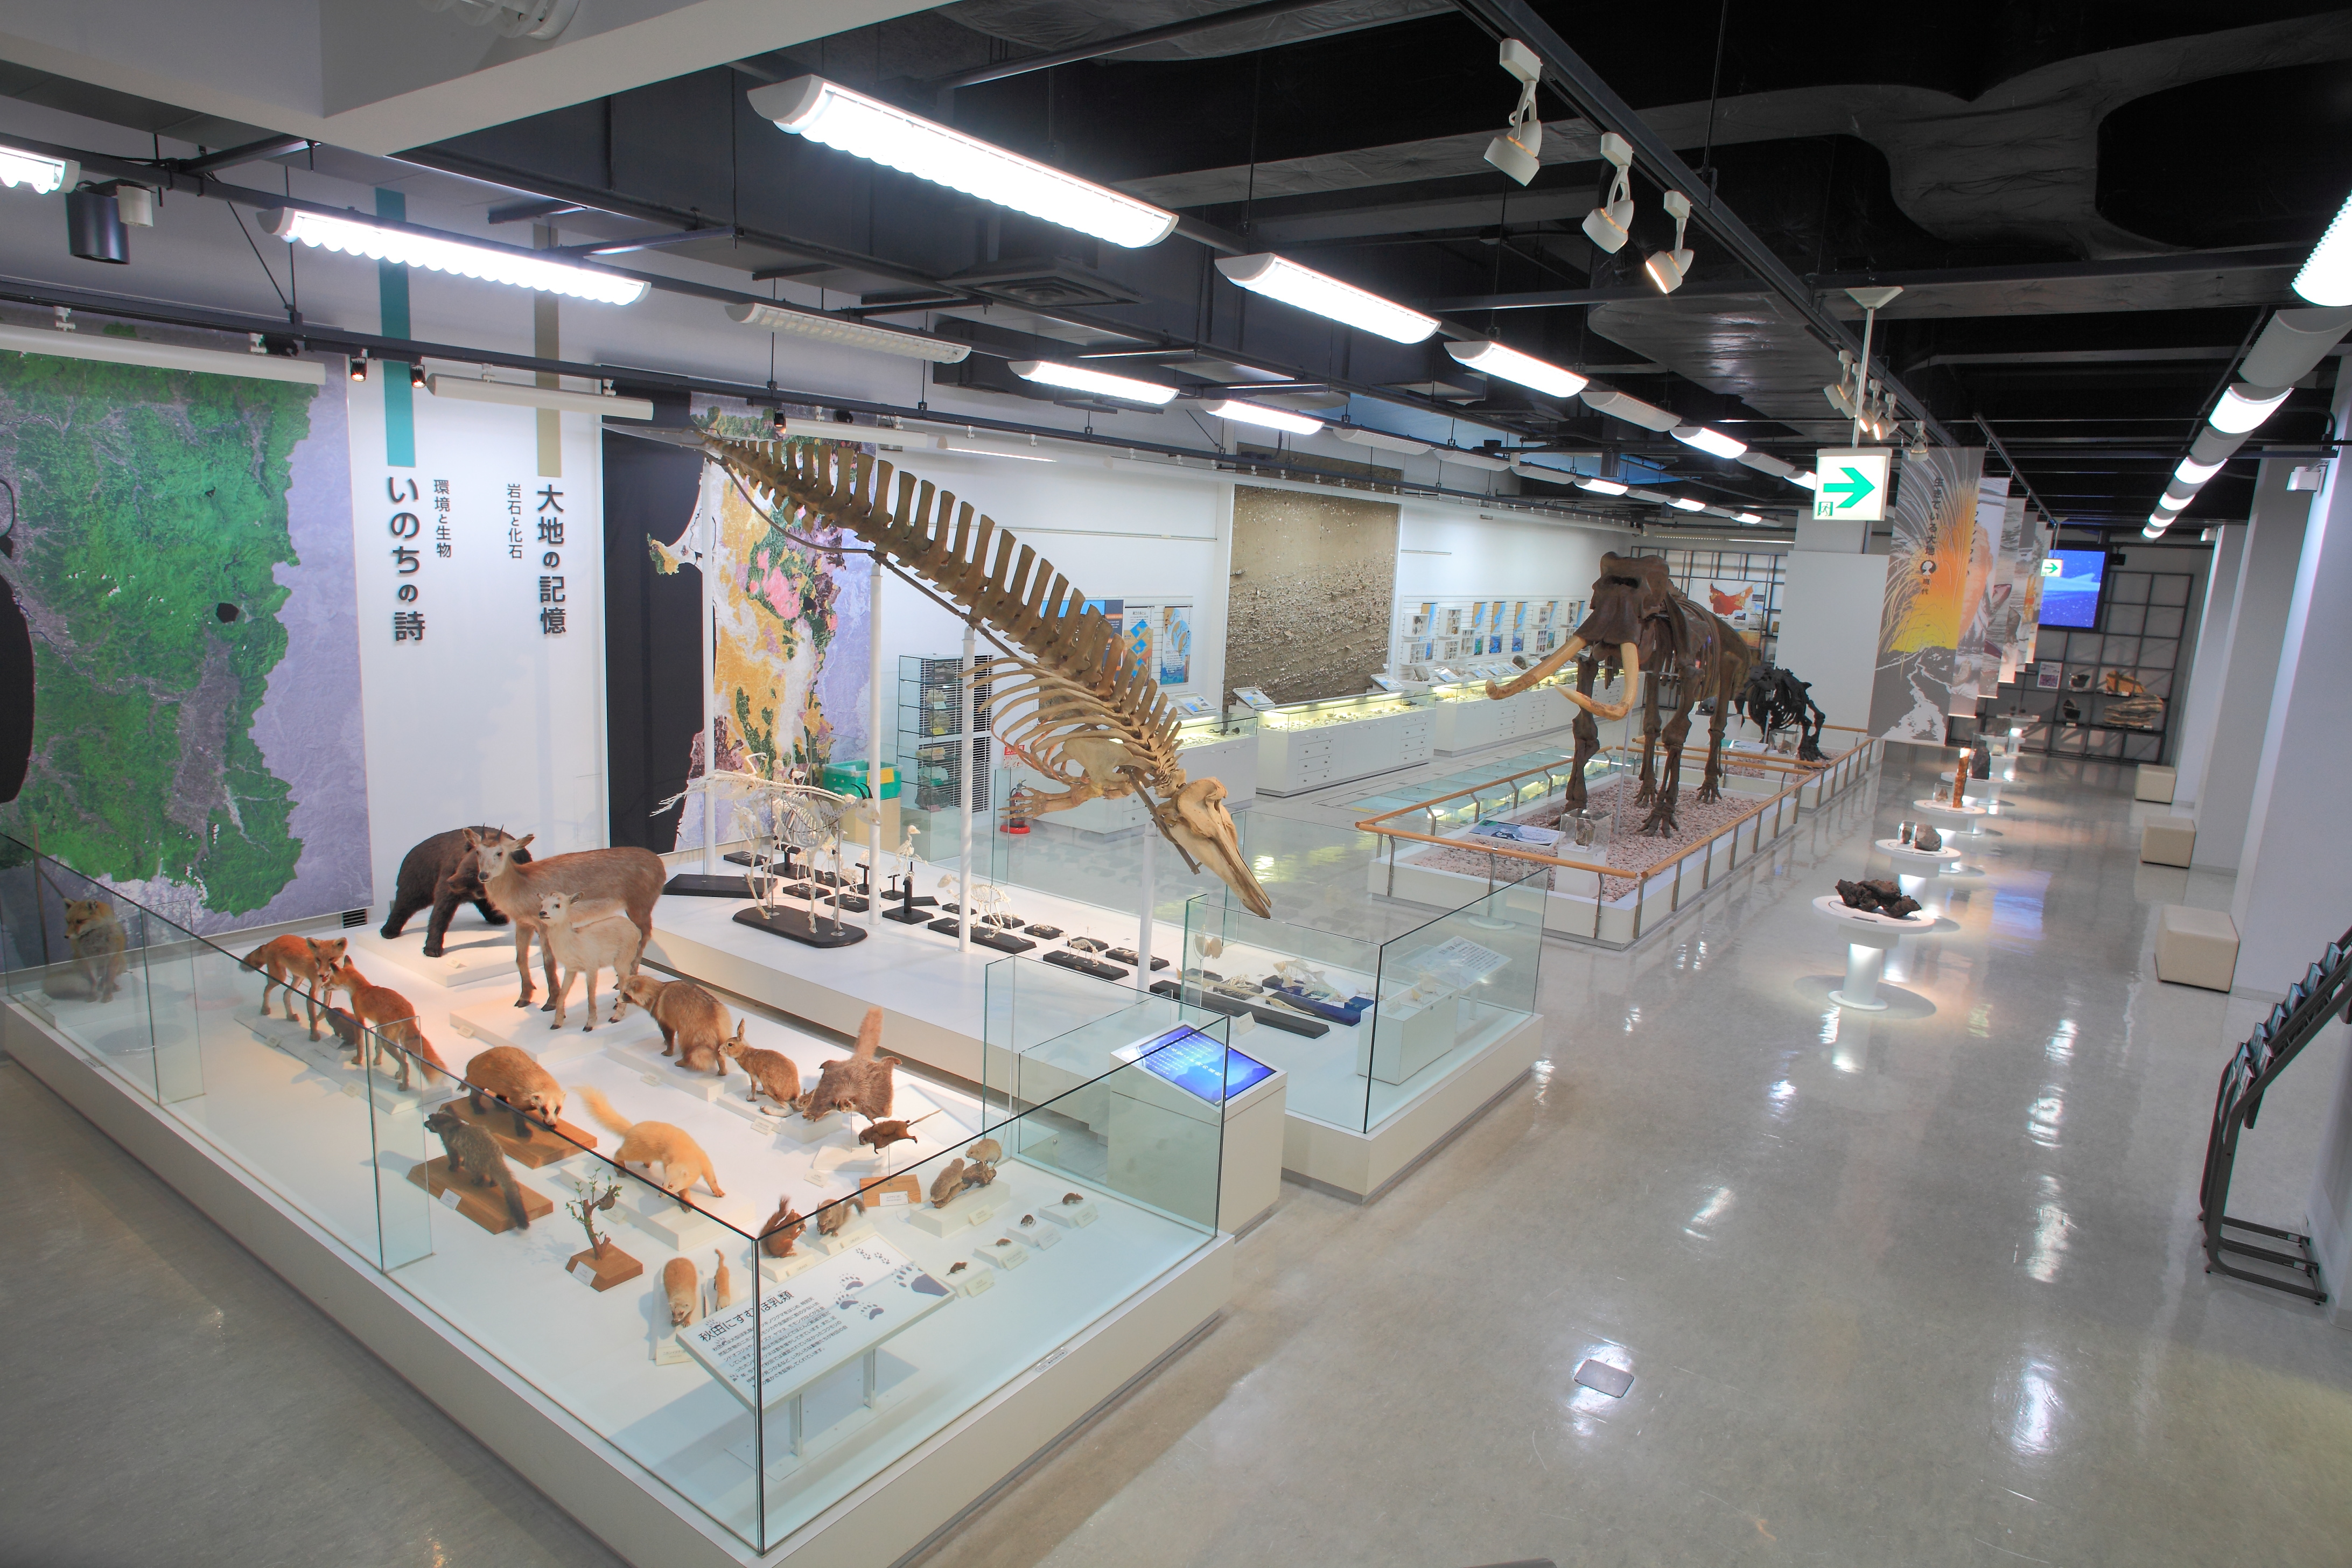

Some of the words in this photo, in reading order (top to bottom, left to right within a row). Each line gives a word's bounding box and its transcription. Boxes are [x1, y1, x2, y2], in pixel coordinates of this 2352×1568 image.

[433, 479, 451, 558] 環境と生物
[507, 483, 523, 559] 岩石と化石
[388, 476, 425, 642] いのちの詩
[537, 485, 566, 635] 大地の記憶
[697, 1290, 795, 1342] 秋田にすむほ乳類
